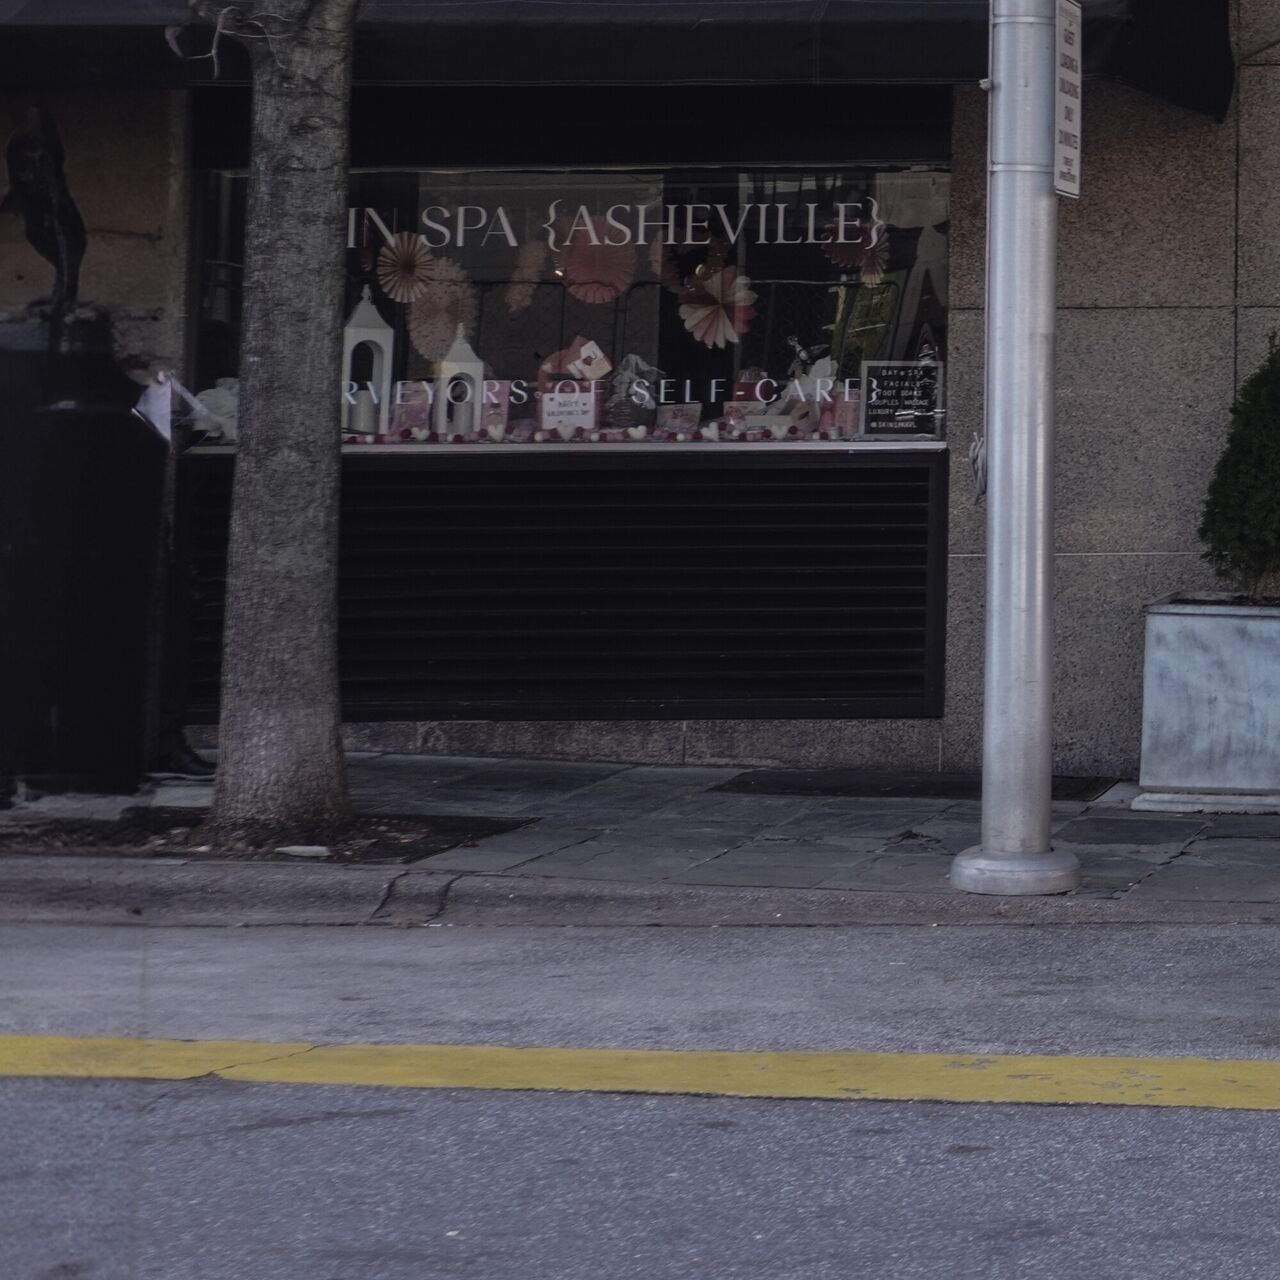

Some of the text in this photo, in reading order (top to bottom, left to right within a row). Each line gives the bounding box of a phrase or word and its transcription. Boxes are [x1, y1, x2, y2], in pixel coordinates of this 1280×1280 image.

[346, 207, 399, 249] IN
[421, 205, 519, 248] SPA
[553, 379, 605, 405] OF
